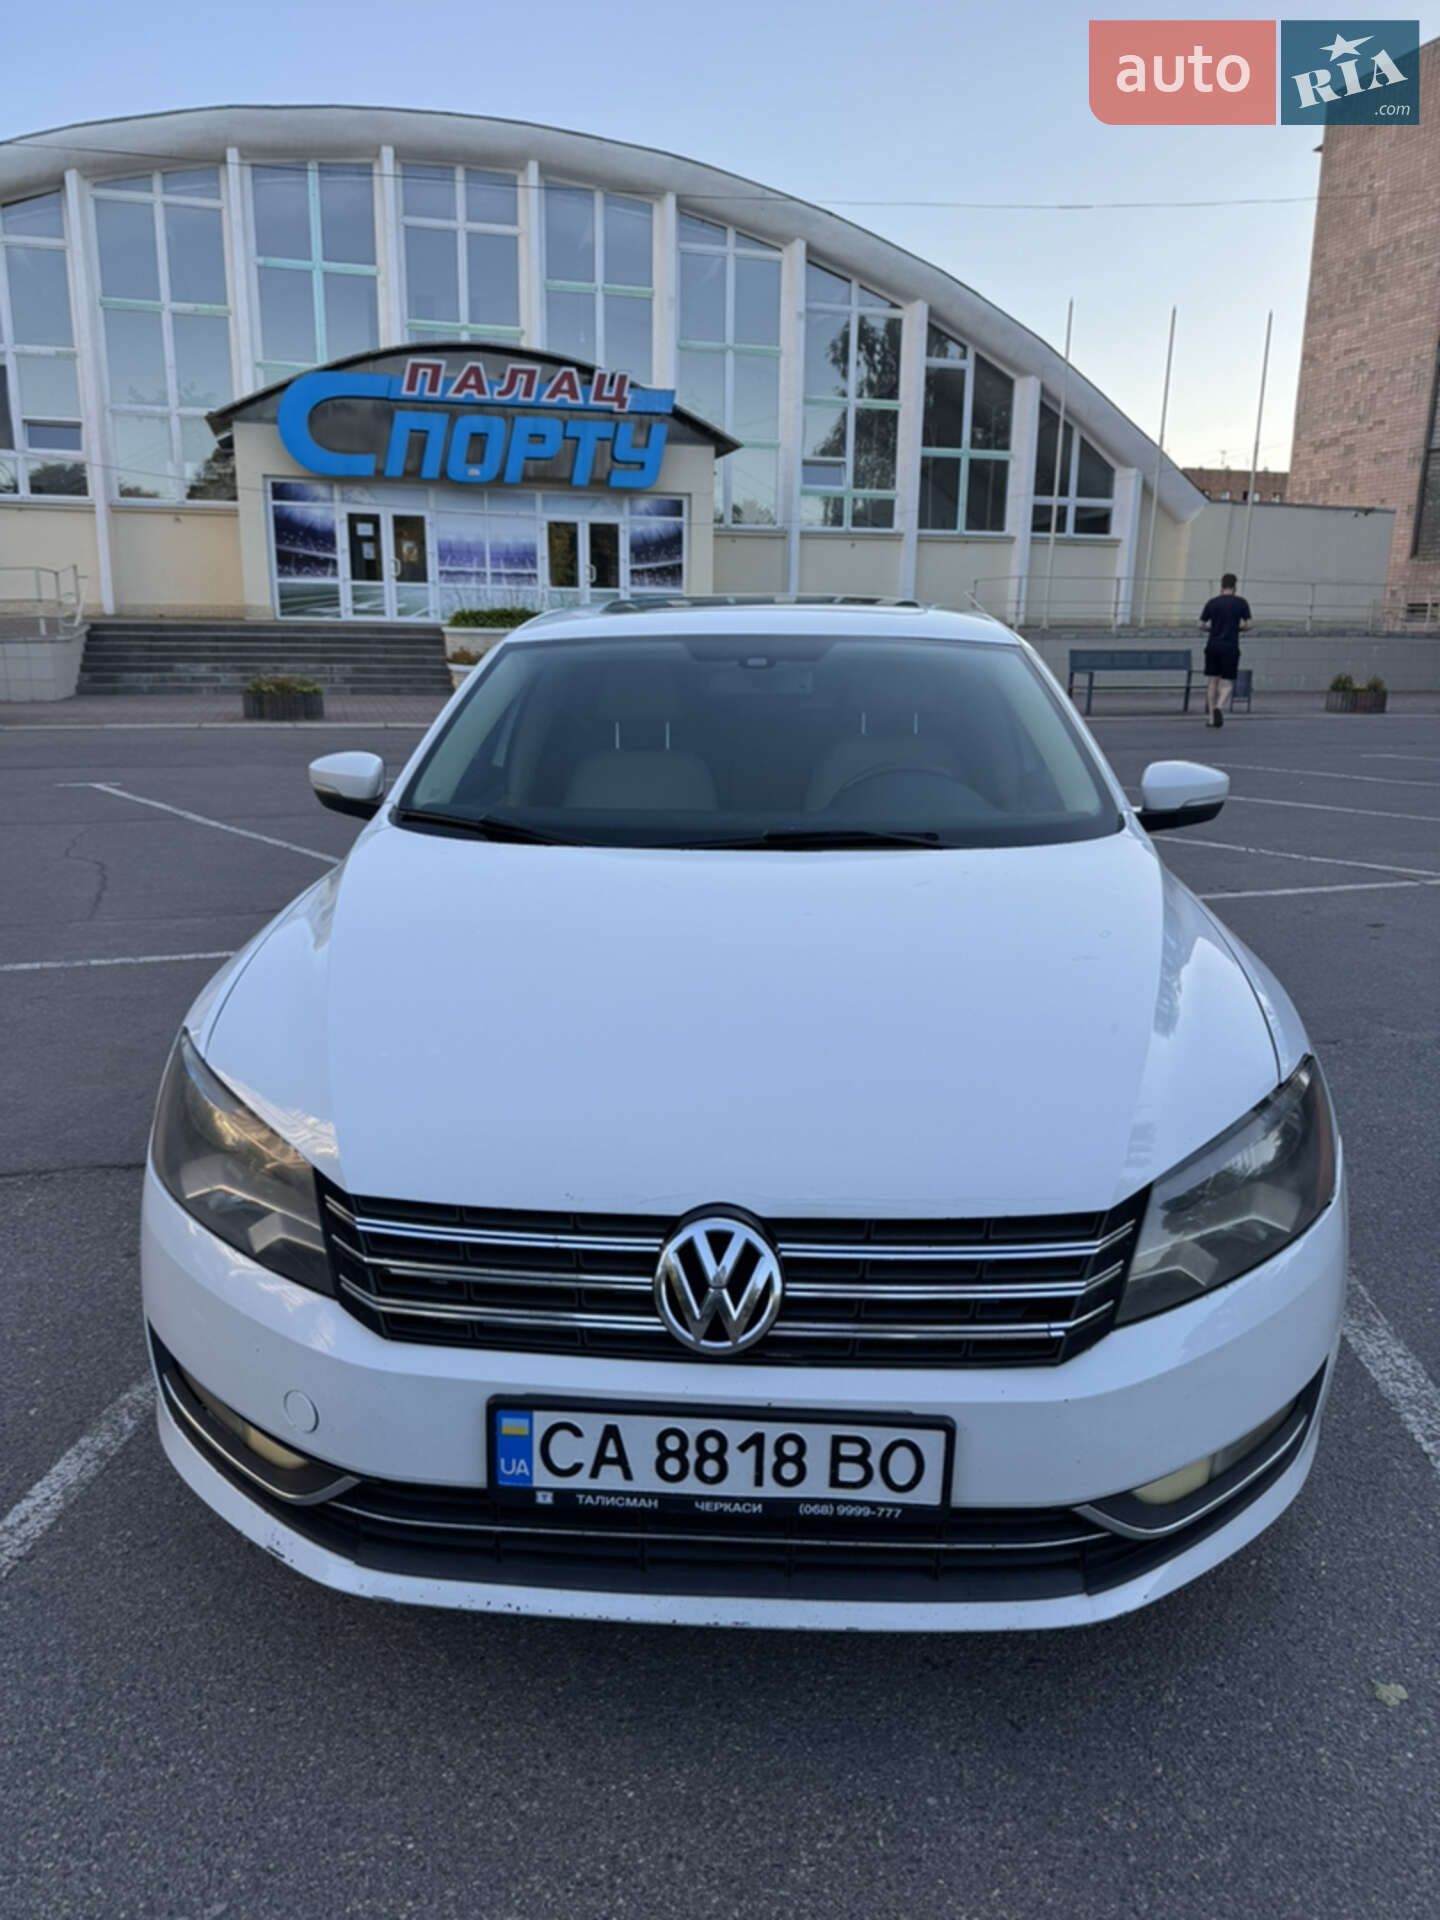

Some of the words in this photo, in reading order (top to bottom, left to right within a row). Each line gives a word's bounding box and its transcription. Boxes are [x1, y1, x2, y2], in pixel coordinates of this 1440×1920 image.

[401, 358, 632, 412] ПАЛАЦ
[277, 370, 676, 489] СПОРТУ
[500, 1457, 530, 1476] UA
[539, 1421, 633, 1480] CA
[655, 1427, 807, 1488] 8818
[829, 1434, 926, 1494] BO
[576, 1494, 659, 1509] ТАЛИСМАН
[694, 1501, 763, 1514] ЧЕРКАСИ
[799, 1503, 834, 1516] (068)
[836, 1505, 902, 1518] 9999-777
